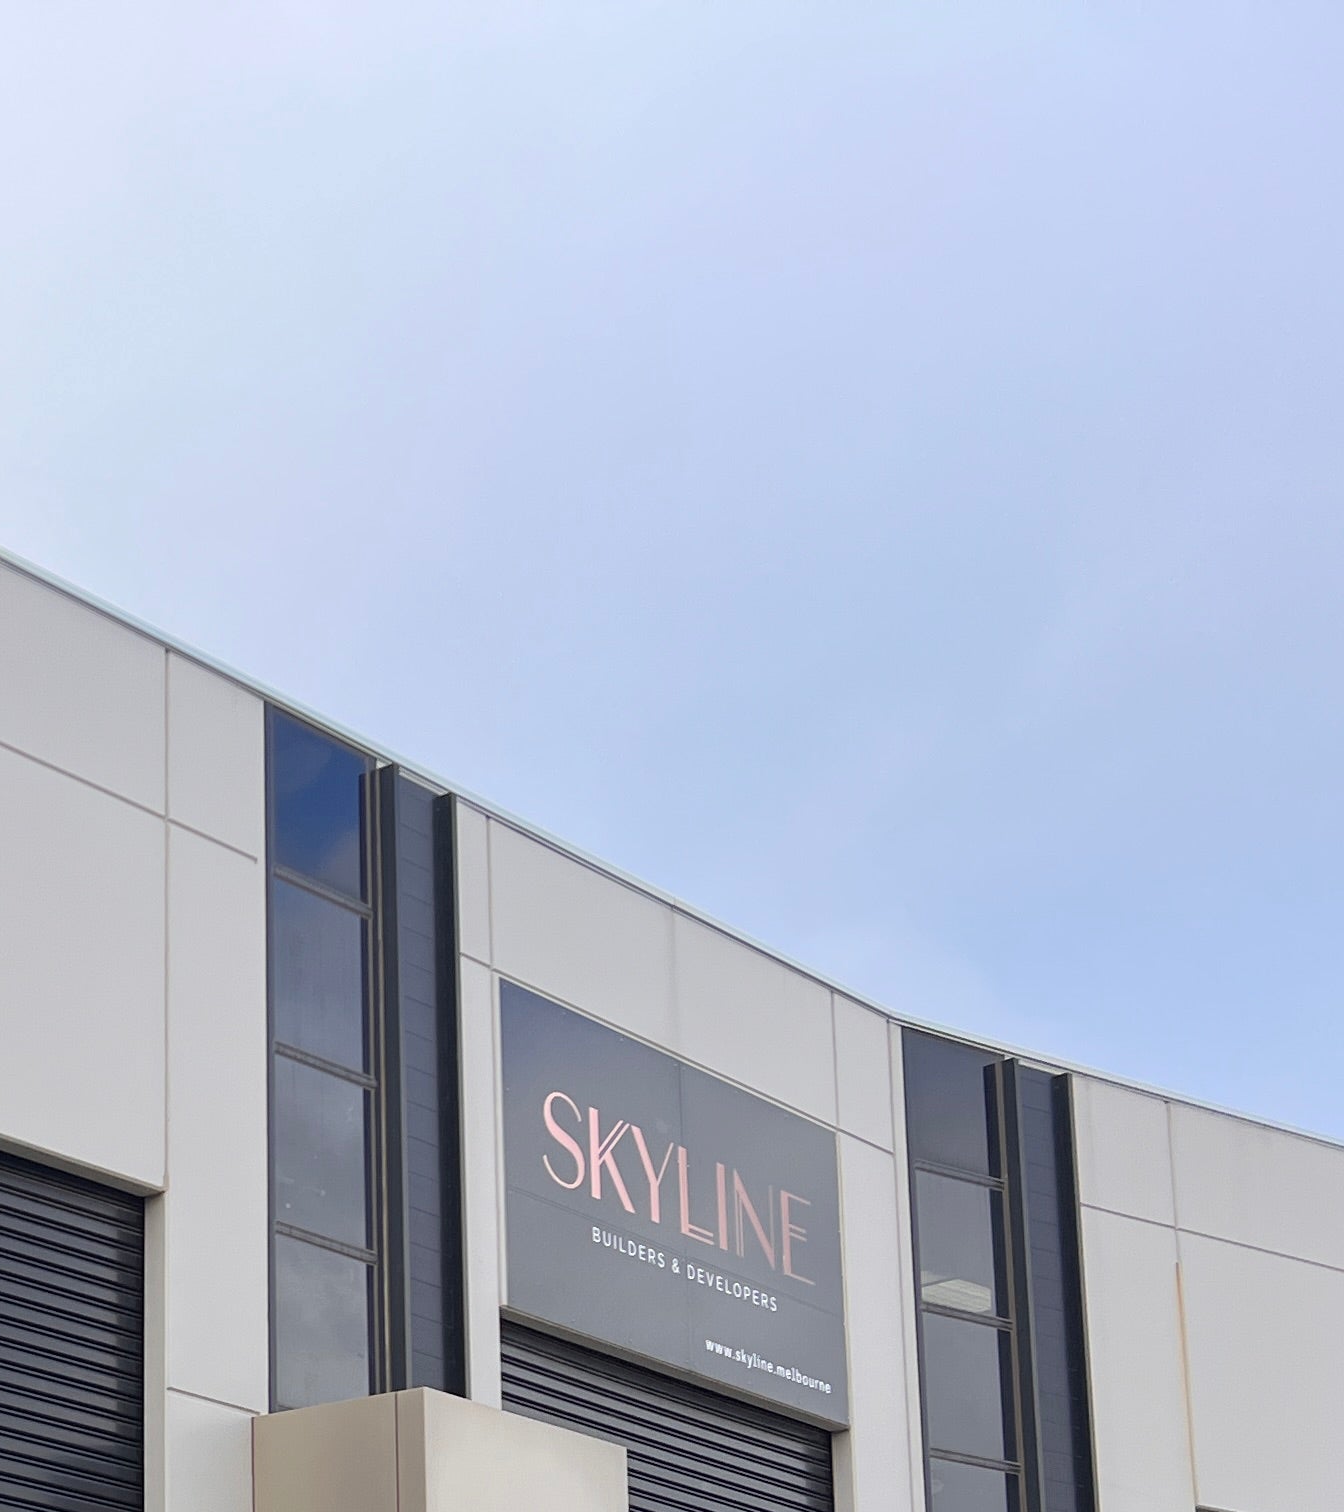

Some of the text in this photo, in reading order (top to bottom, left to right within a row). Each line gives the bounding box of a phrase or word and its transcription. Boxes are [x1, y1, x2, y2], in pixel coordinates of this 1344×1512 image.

[542, 1091, 816, 1286] SKYLINE
[591, 1226, 778, 1313] BUILDERS & DEVELOPERS
[704, 1339, 833, 1394] www.skyline.melbourne
